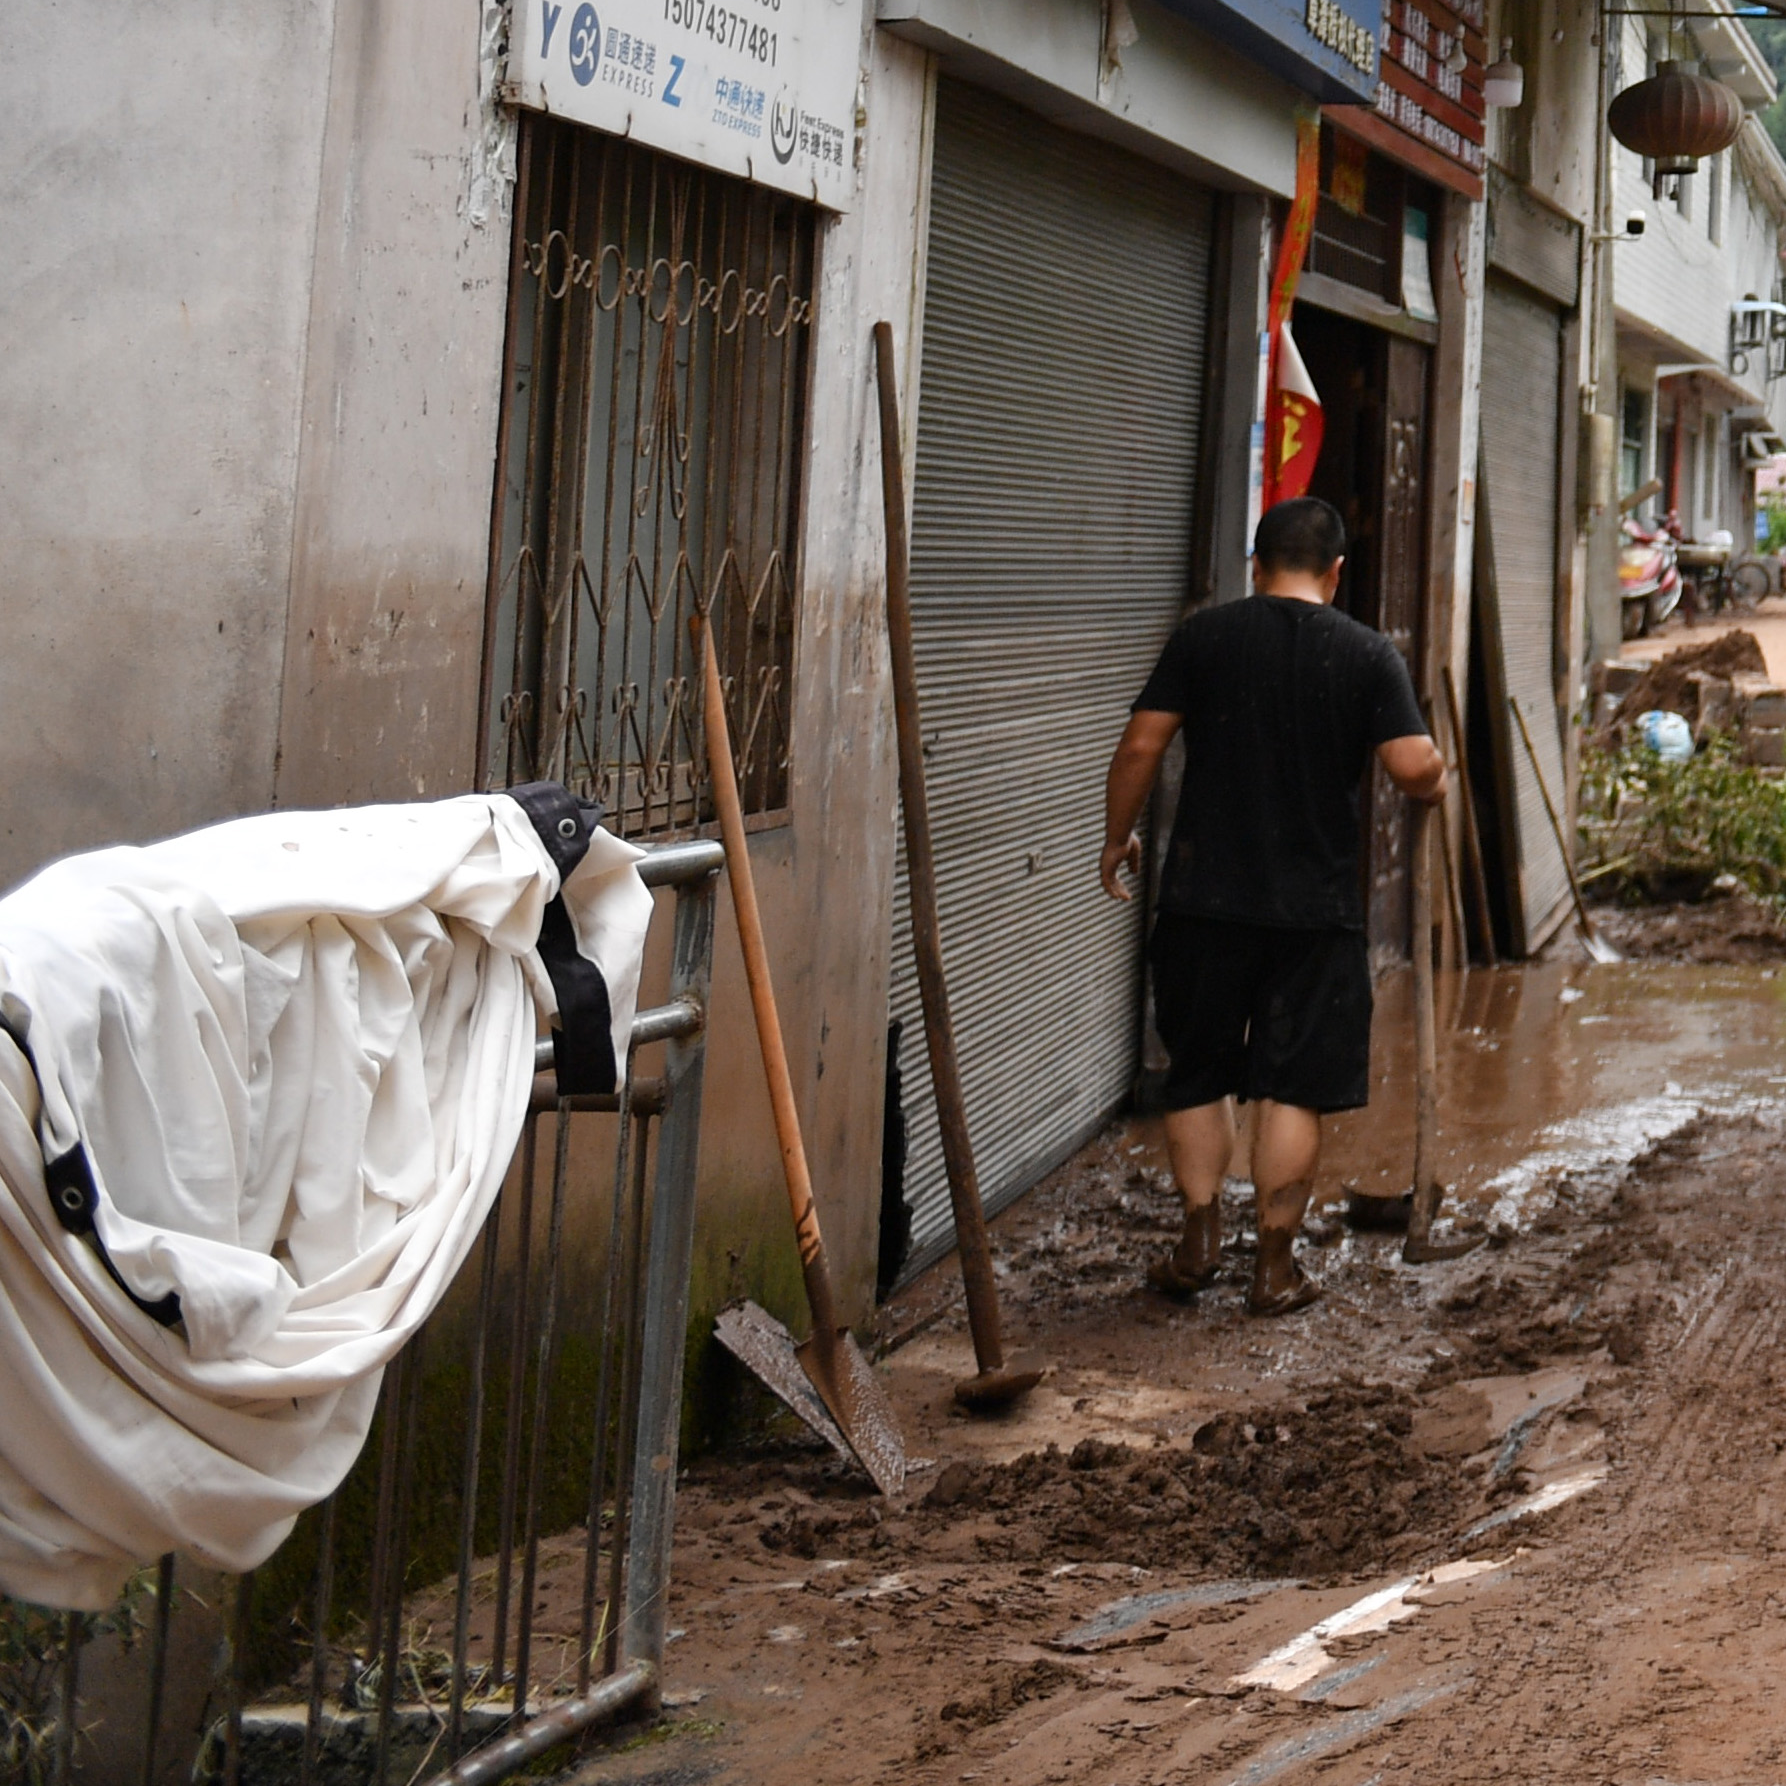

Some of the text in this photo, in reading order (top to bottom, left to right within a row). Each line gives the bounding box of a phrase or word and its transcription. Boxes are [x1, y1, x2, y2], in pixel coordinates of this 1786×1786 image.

[604, 26, 657, 76] 圆通速递
[601, 64, 655, 99] EXPRESS
[715, 75, 766, 121] 中通快递
[727, 113, 762, 140] EXPRESS
